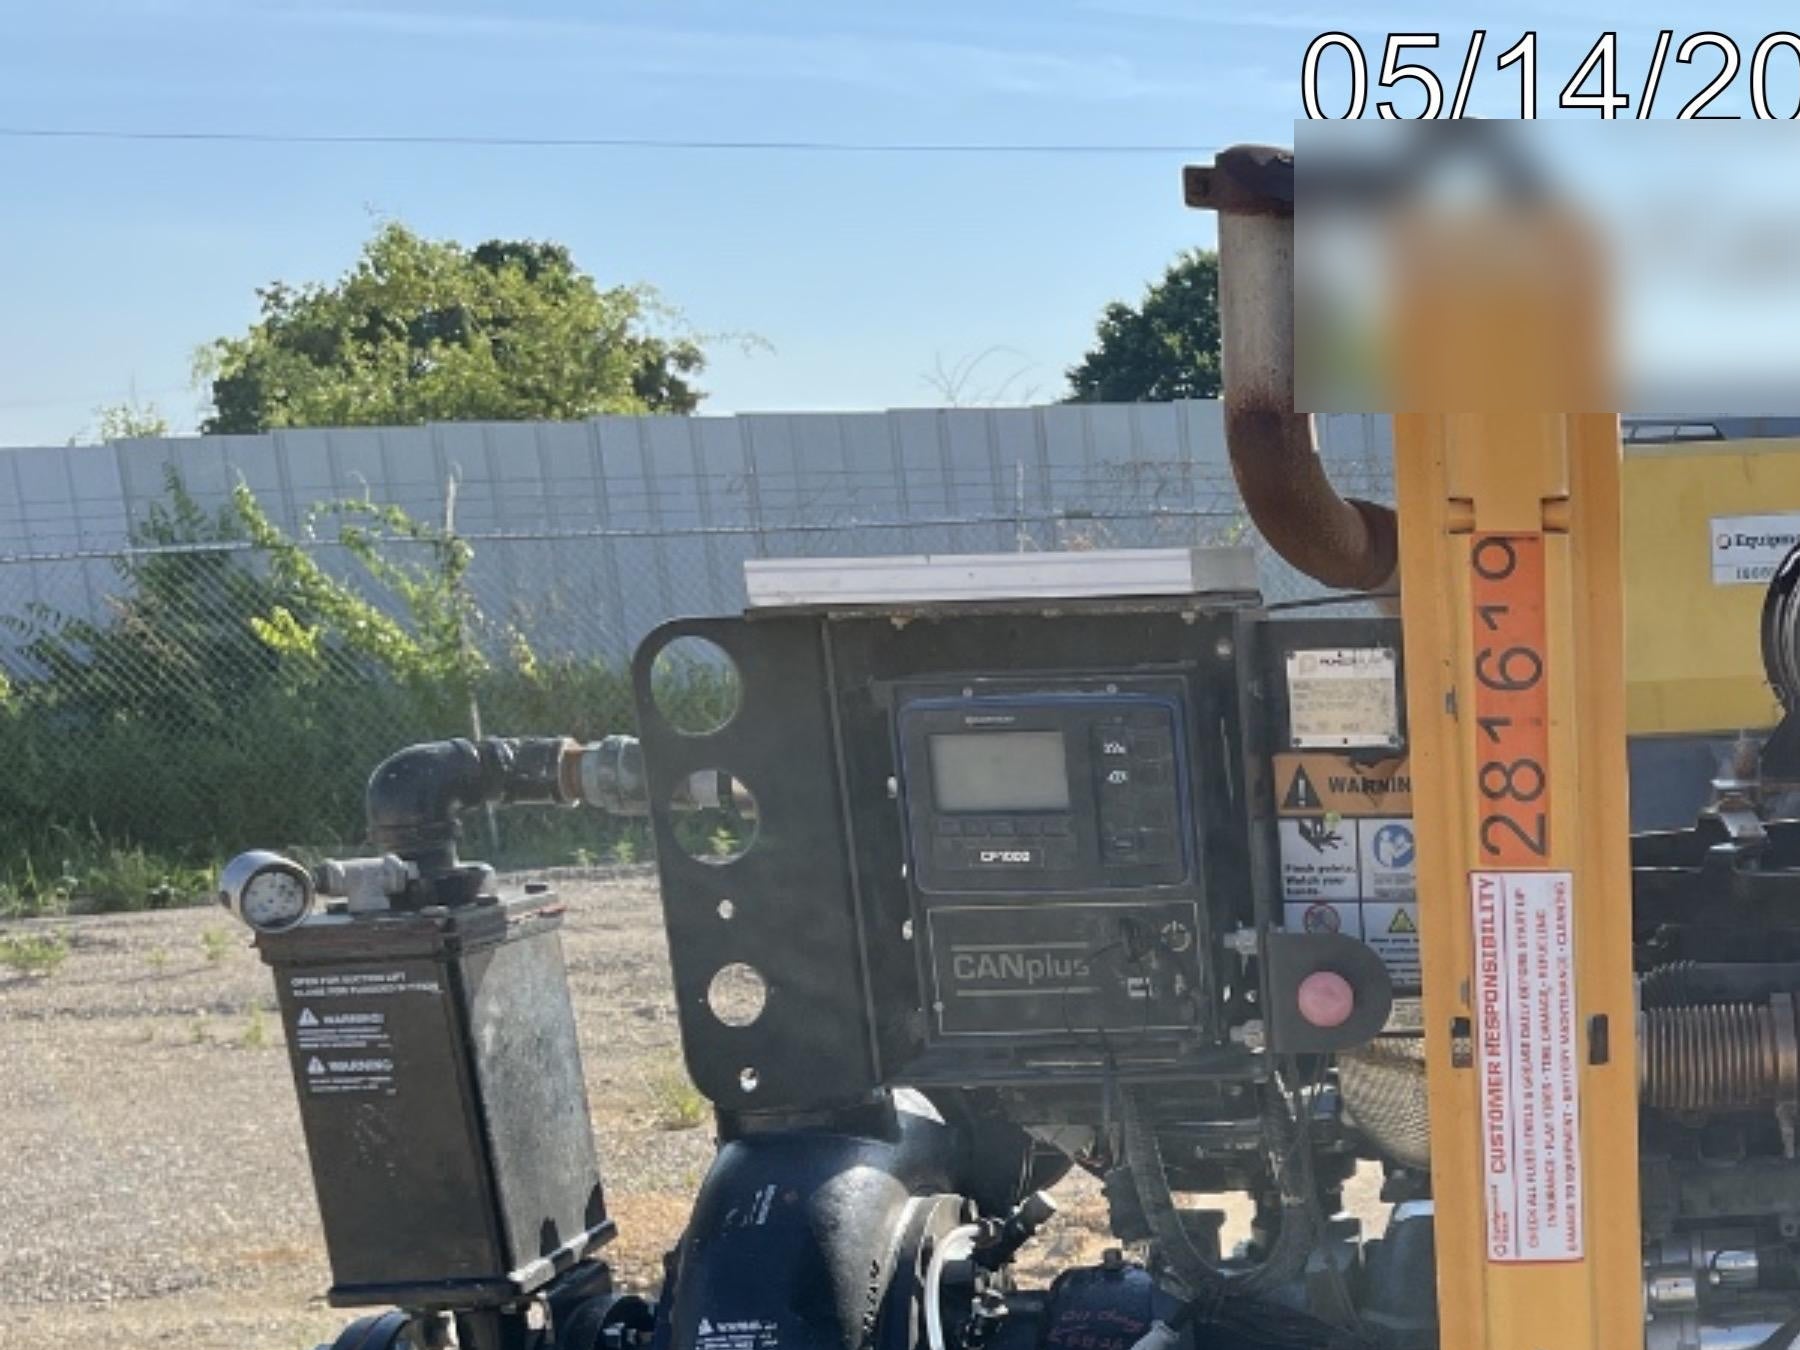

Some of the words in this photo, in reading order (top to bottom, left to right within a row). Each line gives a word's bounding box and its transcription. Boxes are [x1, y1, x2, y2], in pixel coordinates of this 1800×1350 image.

[1472, 536, 1547, 857] 281619
[1328, 774, 1413, 794] WARNIN
[953, 953, 1090, 985] CANplus
[1478, 879, 1501, 1056] RESPONSIBILITY
[1487, 1061, 1506, 1174] CUSTOMER
